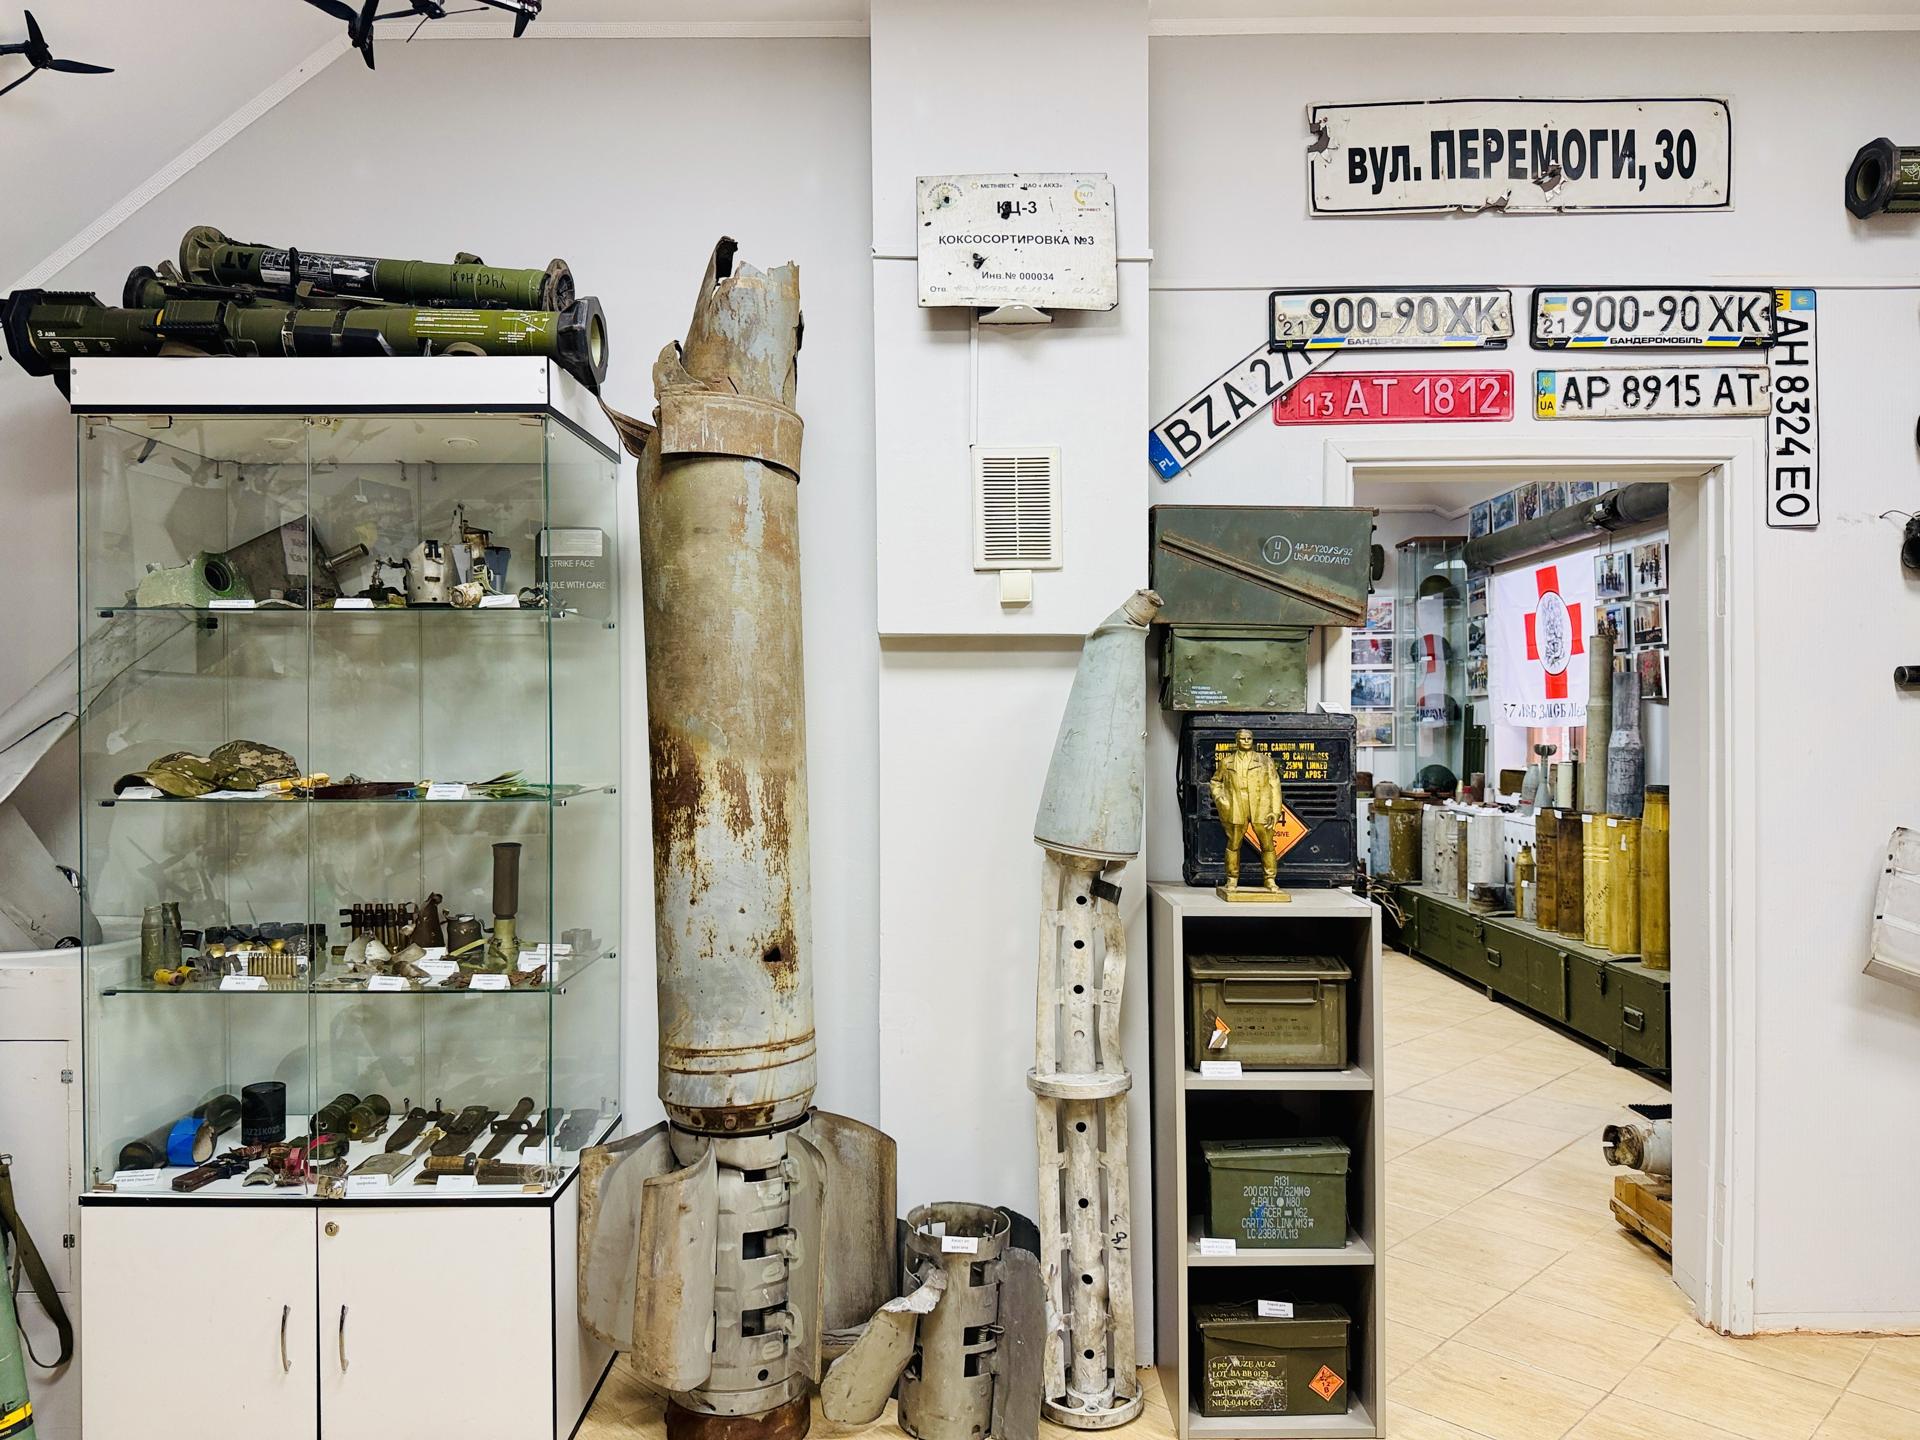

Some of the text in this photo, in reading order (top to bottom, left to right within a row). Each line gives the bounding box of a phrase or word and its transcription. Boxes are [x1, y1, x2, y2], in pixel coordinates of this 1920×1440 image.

[1348, 146, 1422, 195] вул.
[1655, 128, 1698, 180] 30
[938, 234, 1095, 246] КОКСОСОРТИРОВКА №3
[1019, 272, 1055, 281] 000034
[1282, 321, 1305, 335] 21
[1543, 318, 1566, 334] 21
[1609, 336, 1703, 345] БАНДЕРОМОБІЛЬ
[1302, 377, 1501, 417] 13 AT 1812
[1561, 372, 1760, 410] AP 8915 AT
[1540, 401, 1554, 410] UA
[1775, 375, 1811, 456] 8324
[1158, 456, 1175, 472] PL
[1775, 466, 1811, 517] EO
[550, 560, 595, 568] STRIKE FACE
[566, 581, 585, 589] WITH
[586, 581, 607, 590] CARE
[1256, 742, 1315, 752] FOR CANNON WITH
[1285, 761, 1328, 770] 25MM LINKED
[1274, 1175, 1289, 1186] A131
[1243, 1185, 1258, 1197] 200
[1258, 1186, 1278, 1197] CRTG
[1276, 1217, 1294, 1229] LINK
[1294, 1218, 1308, 1229] M13
[1255, 1360, 1277, 1368] AU-62
[1212, 1371, 1227, 1379] LOT
